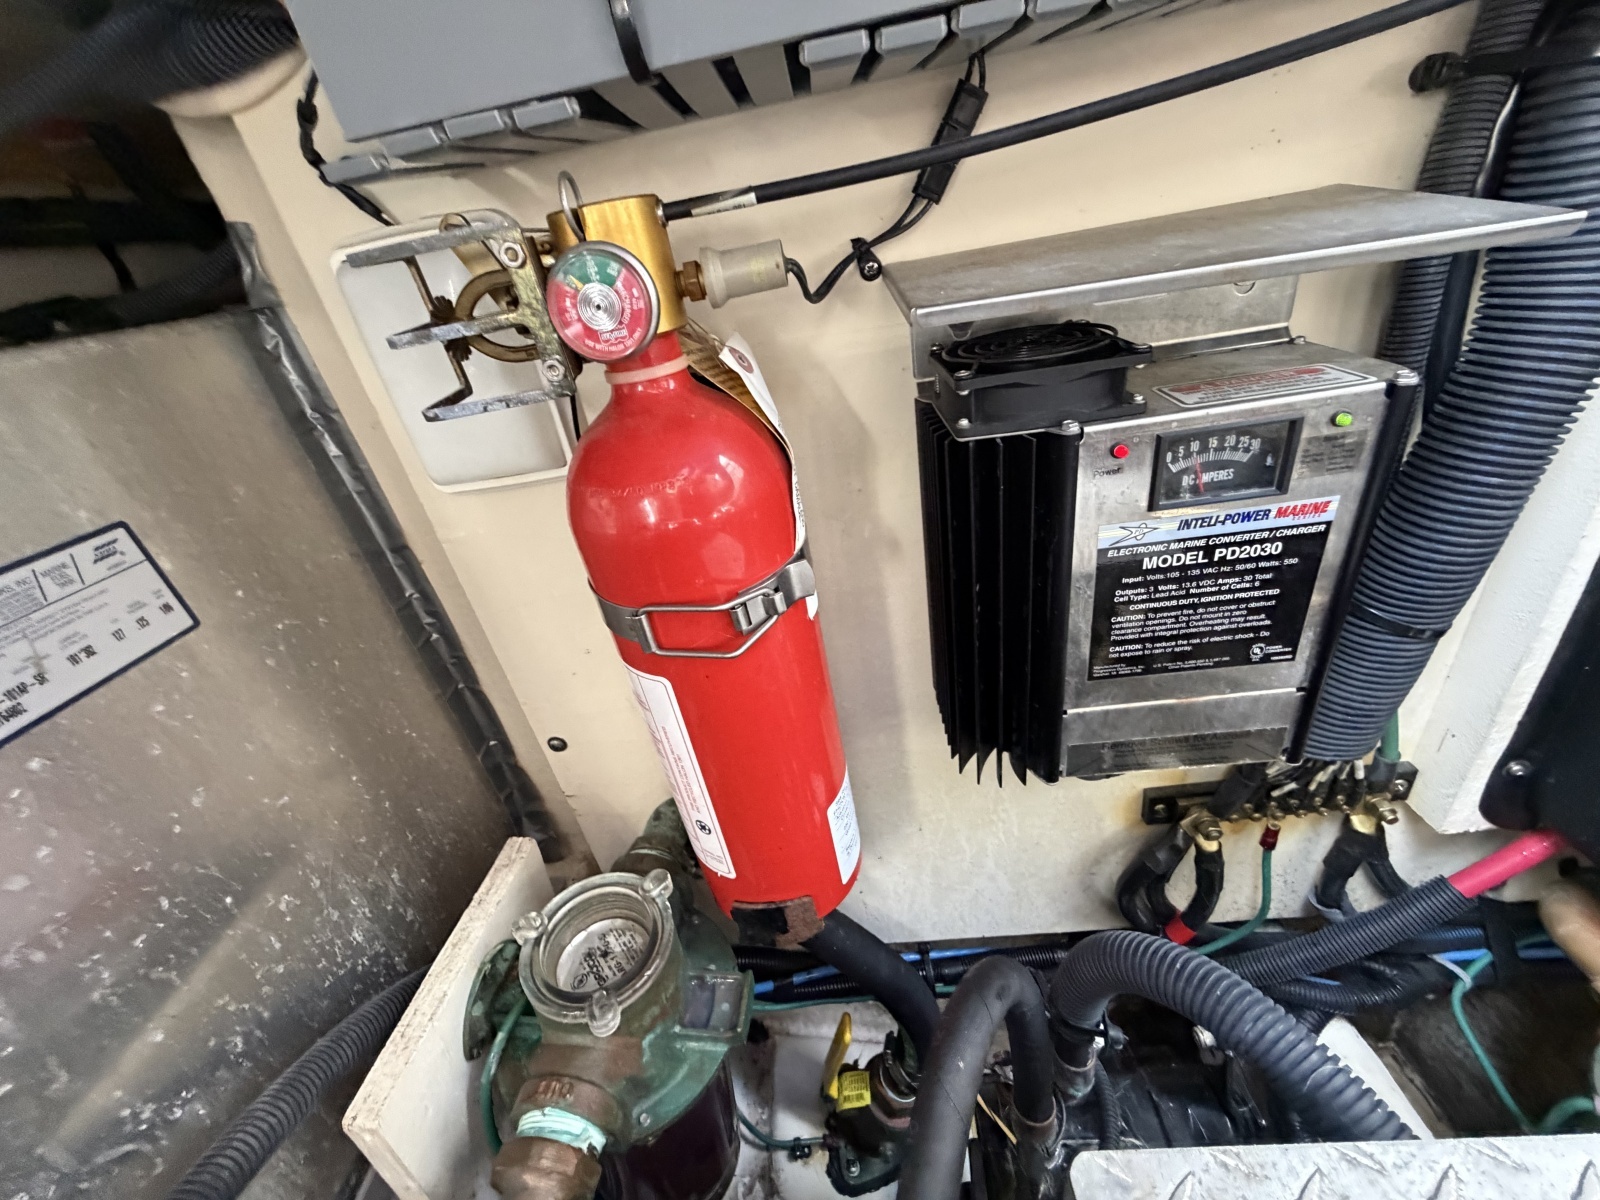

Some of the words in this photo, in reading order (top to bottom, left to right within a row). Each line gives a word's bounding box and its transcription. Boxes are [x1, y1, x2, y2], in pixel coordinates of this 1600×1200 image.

[595, 342, 608, 351] WITH
[609, 343, 624, 351] HALON
[1166, 452, 1172, 463] 0
[1178, 445, 1185, 457] 5
[1190, 440, 1200, 452] 10
[1208, 436, 1218, 448] 15
[1224, 434, 1237, 447] 20
[1238, 436, 1250, 448] 25
[1250, 438, 1261, 450] 30
[1093, 466, 1122, 479] Power
[1182, 474, 1195, 486] DC
[1177, 509, 1272, 531] INTELI-POWER
[1274, 501, 1333, 519] MARINE
[1107, 544, 1168, 558] ELECTRONIC
[1169, 538, 1207, 550] MARINE
[1209, 531, 1269, 545] CONVERTER
[1276, 524, 1327, 537] CHARGER
[1142, 550, 1209, 570] MODEL
[1214, 542, 1283, 562] PD2030
[1122, 576, 1144, 584] Input:
[1202, 566, 1219, 574] VAC
[1235, 562, 1256, 571] 50/60
[1258, 560, 1282, 568] Watts:
[1283, 557, 1299, 565] 550
[1113, 595, 1129, 603] Cell
[1189, 585, 1220, 594] Number
[1231, 582, 1253, 590] Cells:
[1115, 587, 1148, 596] Outputs:
[1217, 577, 1241, 585] Amps:
[1129, 600, 1178, 610] CONTINUOUS
[1178, 597, 1200, 605] DUTY,
[1200, 594, 1233, 603] IGNITION
[1234, 588, 1280, 599] PROTECTED
[1111, 614, 1146, 623] CAUTION:
[1156, 610, 1181, 619] prevent
[1248, 600, 1276, 608] obstruct
[1111, 621, 1144, 629] ventilation
[1111, 627, 1142, 635] clearance
[1189, 618, 1229, 626] Overheating
[1180, 627, 1212, 635] protection
[1213, 623, 1238, 631] against
[1109, 644, 1143, 652] CAUTION:
